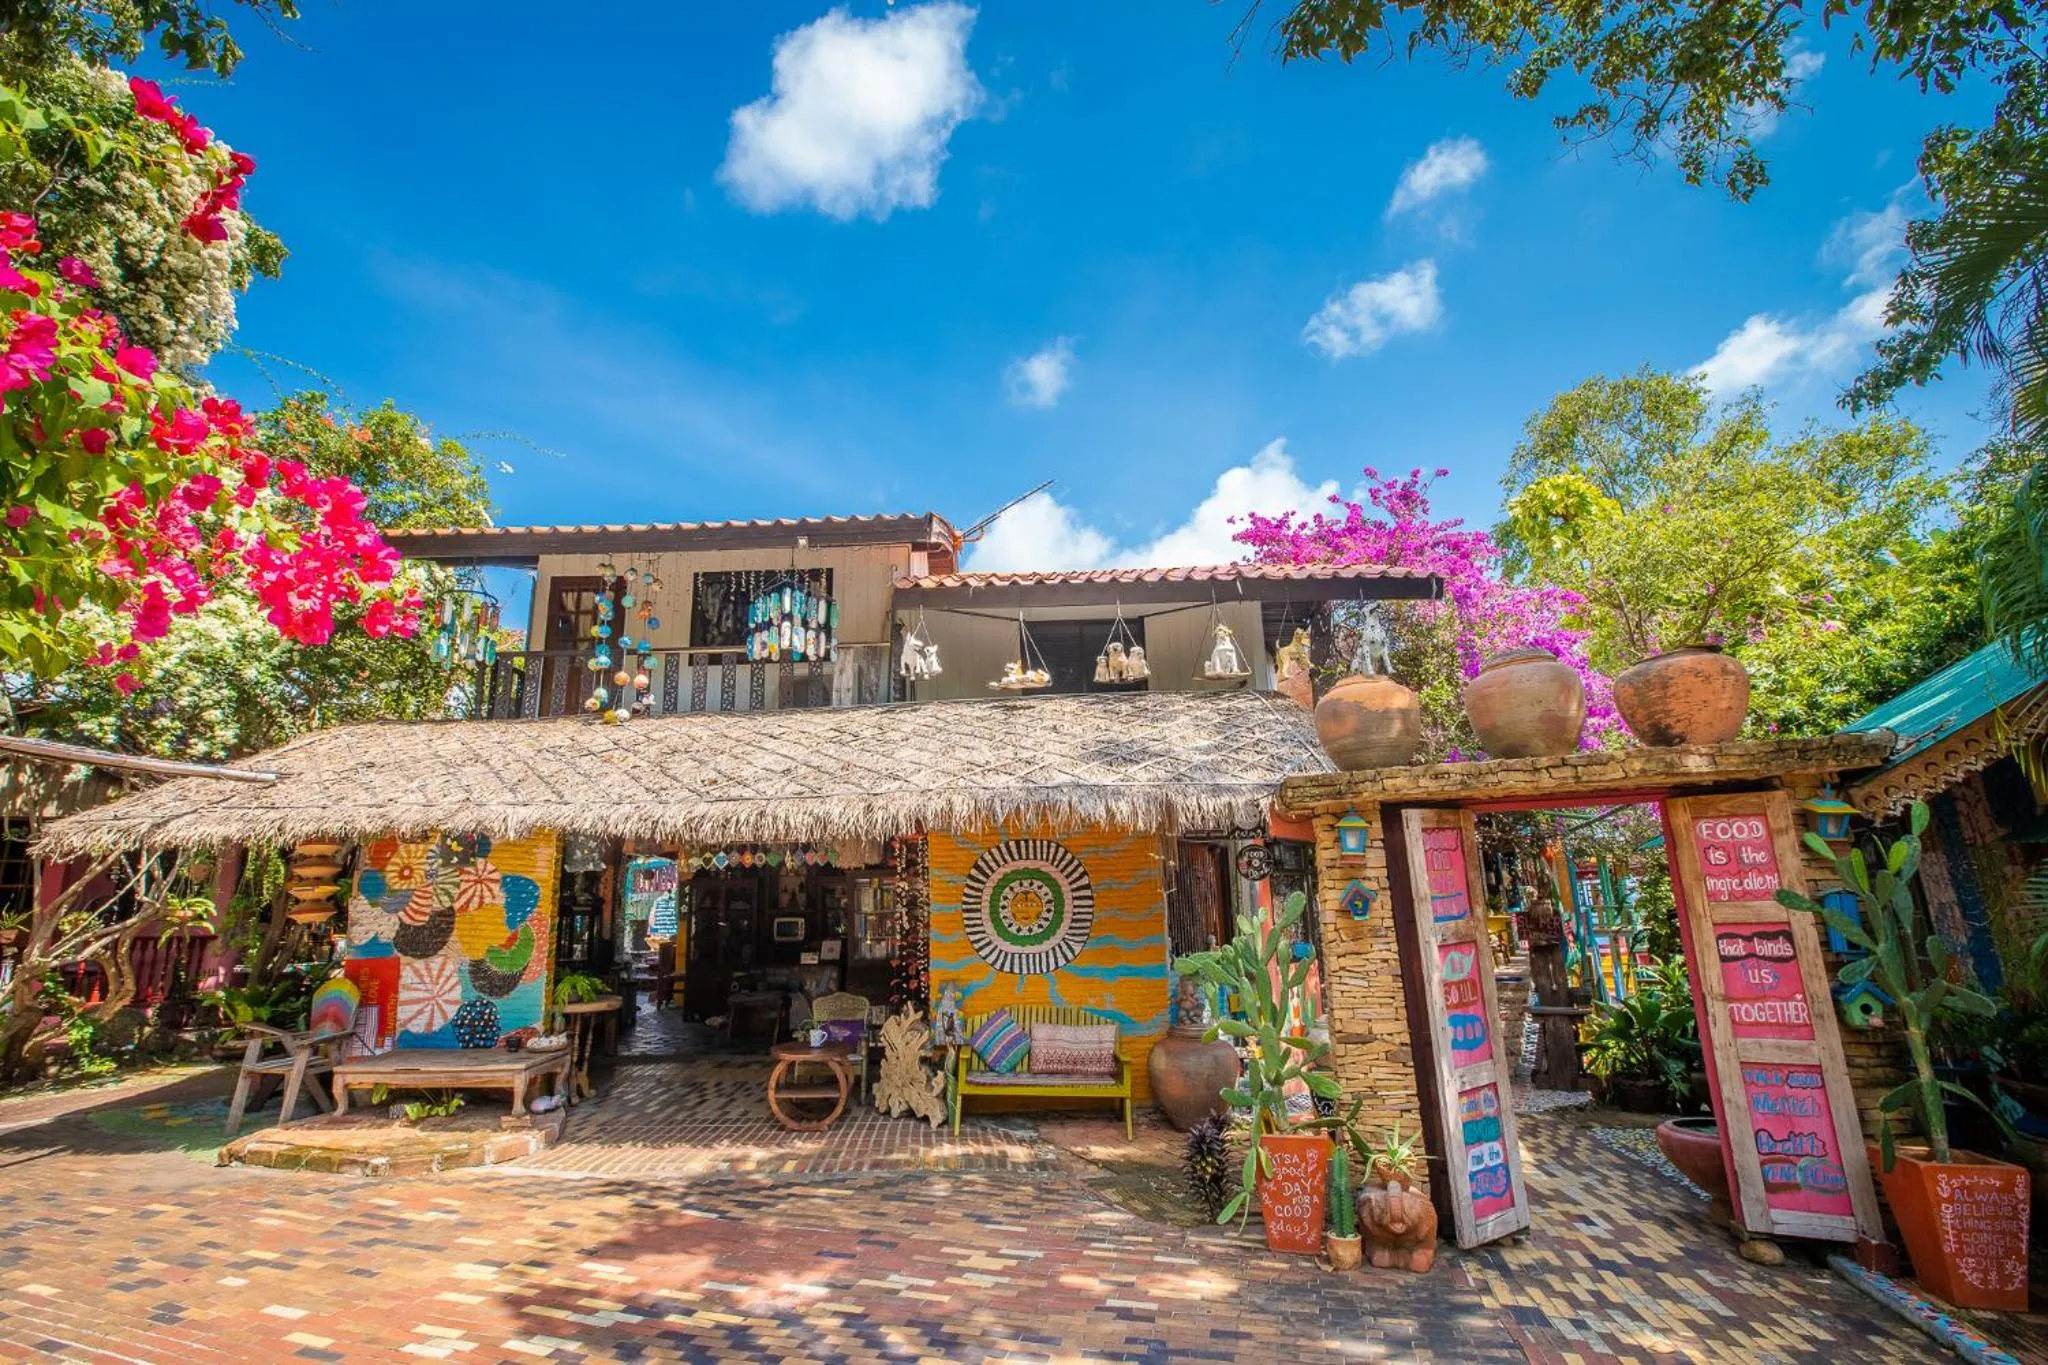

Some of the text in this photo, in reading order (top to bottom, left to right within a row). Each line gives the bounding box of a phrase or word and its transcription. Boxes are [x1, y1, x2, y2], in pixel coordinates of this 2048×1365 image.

[1700, 819, 1764, 840] FOOD
[1709, 845, 1769, 865] is the
[1706, 872, 1780, 900] ingredient
[1718, 937, 1794, 956] that binds
[1443, 981, 1478, 1006] SOUL
[1728, 1002, 1811, 1024] TOGETHER
[1275, 1162, 1306, 1180] good
[1281, 1178, 1312, 1197] DAY
[1274, 1204, 1312, 1218] GOOD
